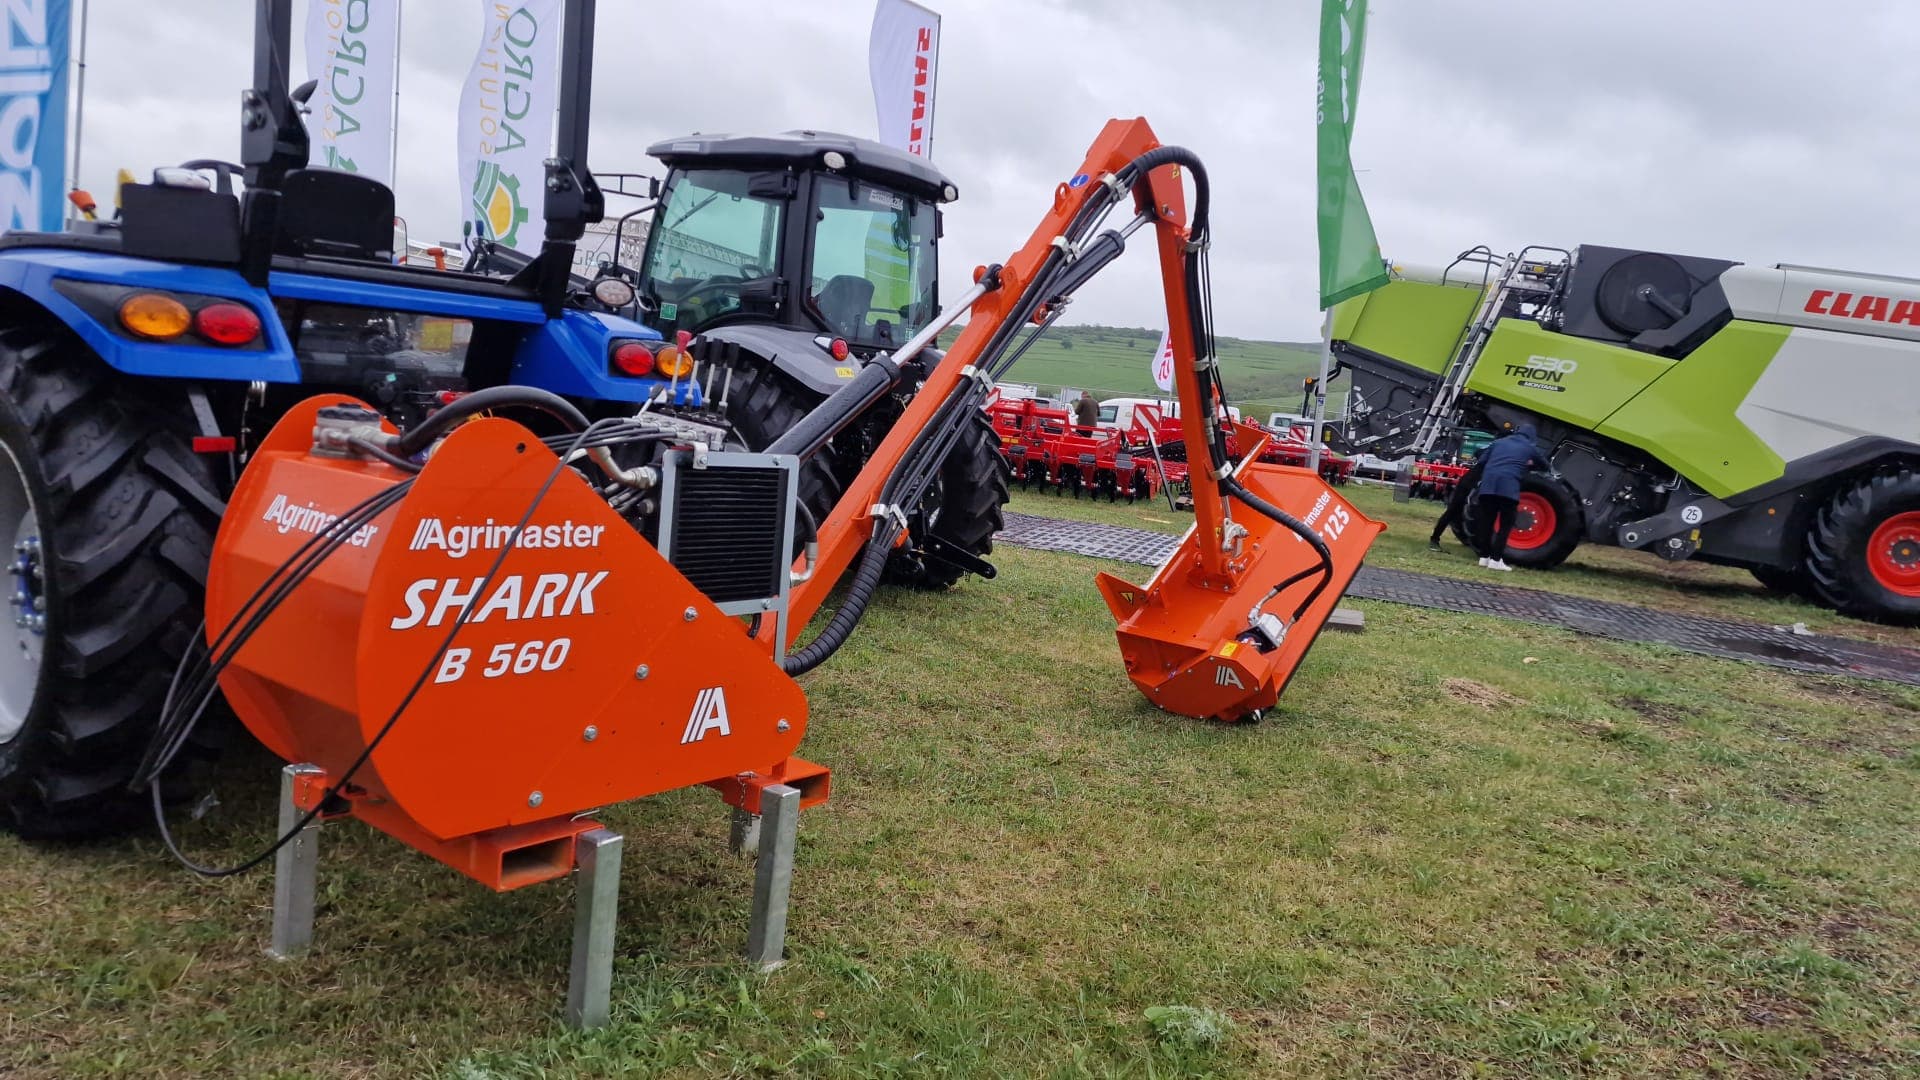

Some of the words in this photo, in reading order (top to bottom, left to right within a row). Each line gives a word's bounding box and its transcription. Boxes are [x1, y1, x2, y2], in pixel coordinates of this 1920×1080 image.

[1504, 364, 1564, 383] TRION
[1526, 354, 1578, 374] 530
[1324, 505, 1350, 541] 125
[1686, 508, 1698, 521] 25
[409, 518, 604, 558] Agrimaster
[390, 571, 609, 629] SHARK
[434, 648, 471, 684] B
[483, 638, 571, 677] 560
